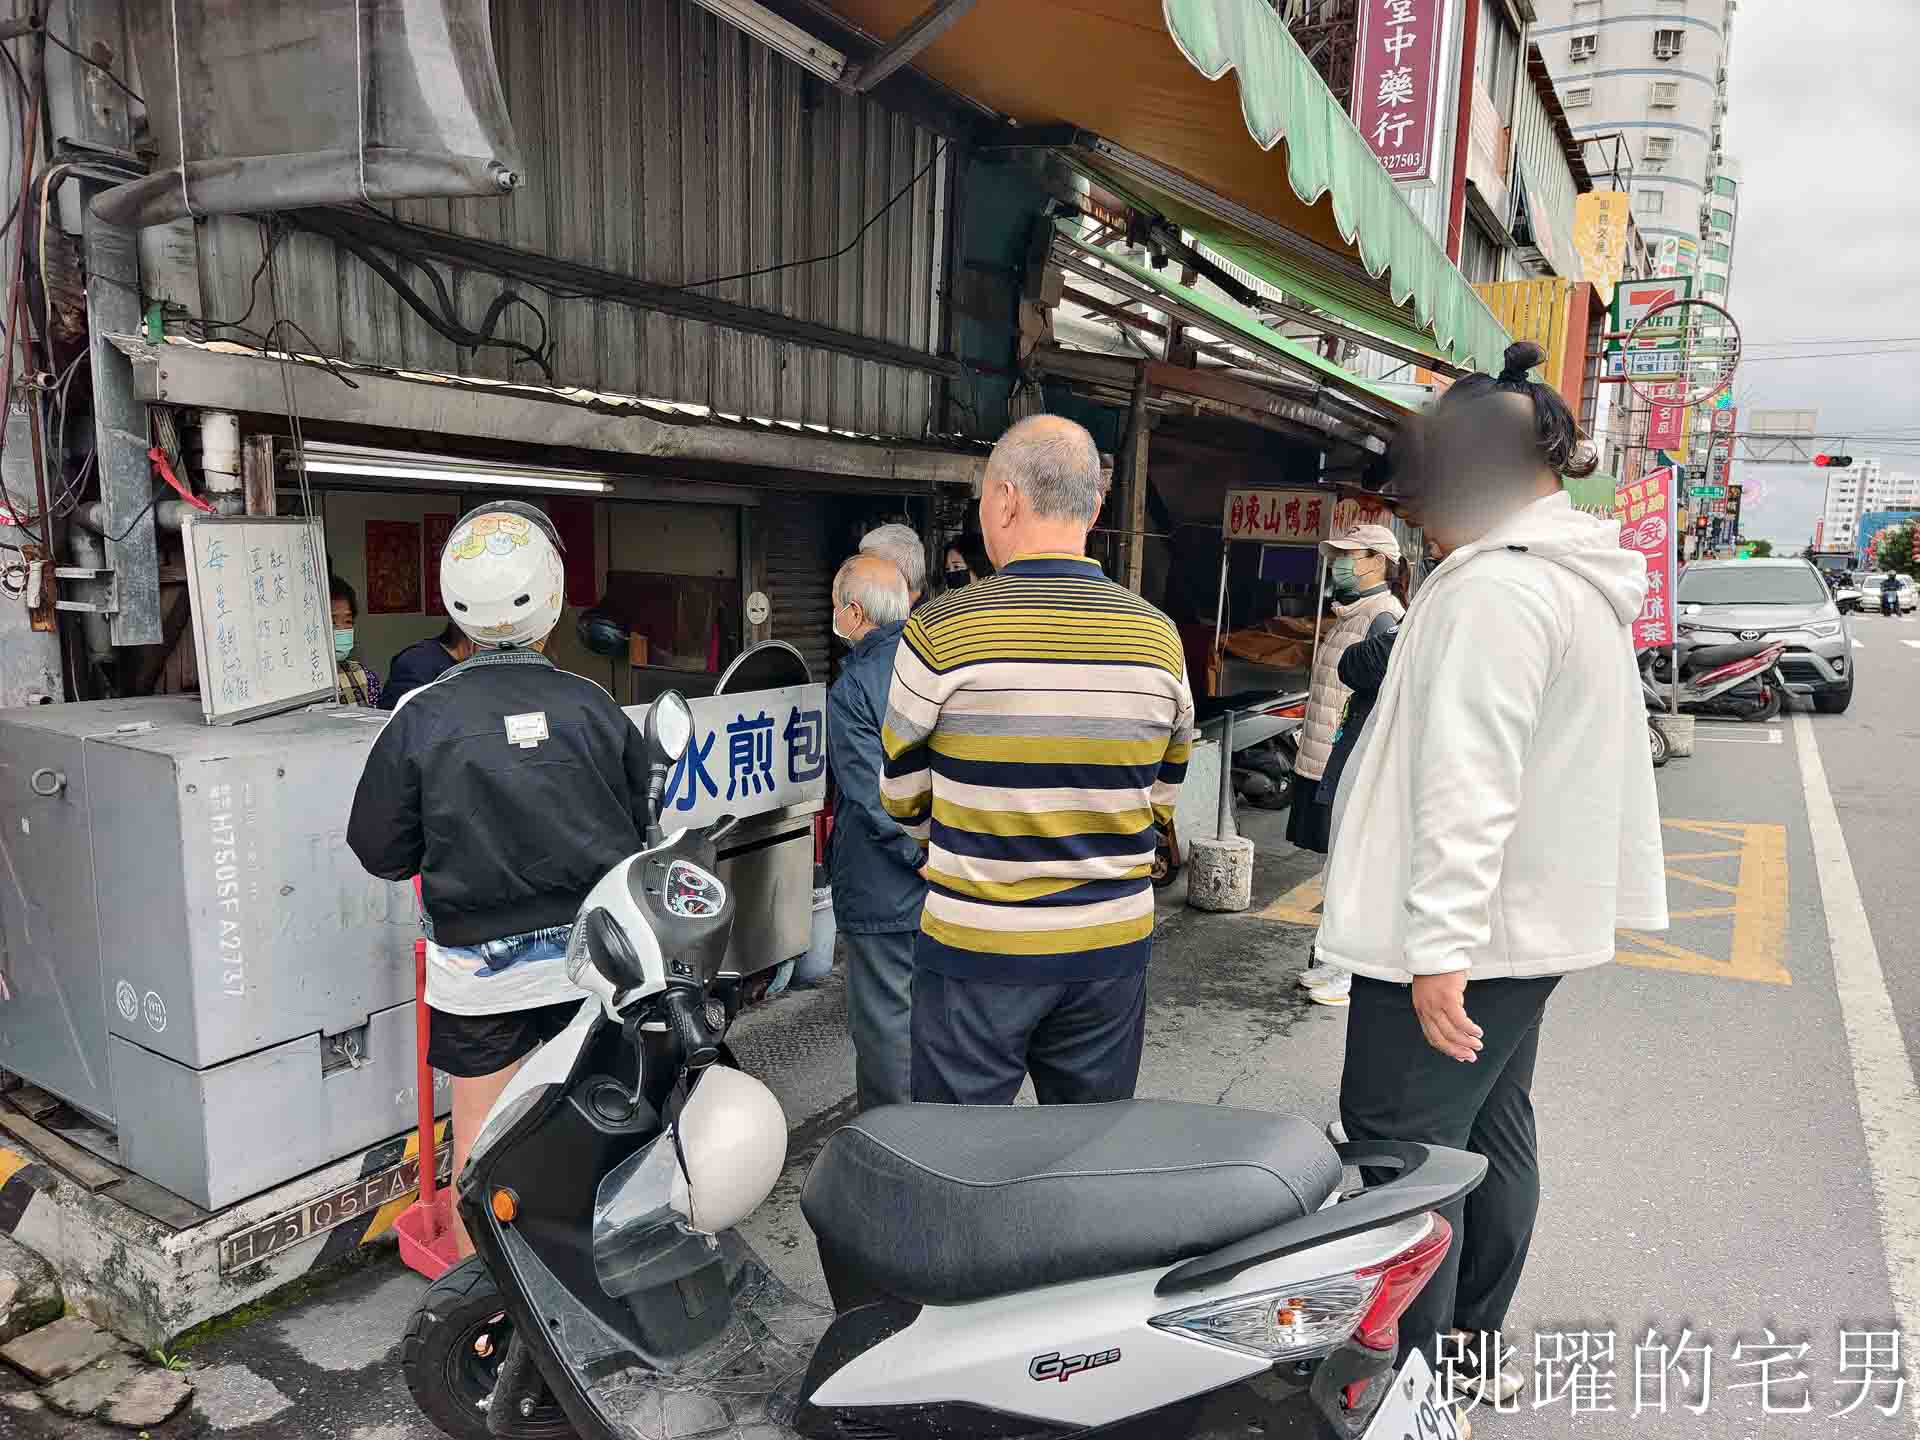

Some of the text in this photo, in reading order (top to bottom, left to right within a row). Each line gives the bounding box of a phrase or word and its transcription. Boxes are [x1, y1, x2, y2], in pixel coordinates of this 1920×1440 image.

[1244, 493, 1323, 536] 東山鴨頭
[663, 706, 825, 811] 水煎包
